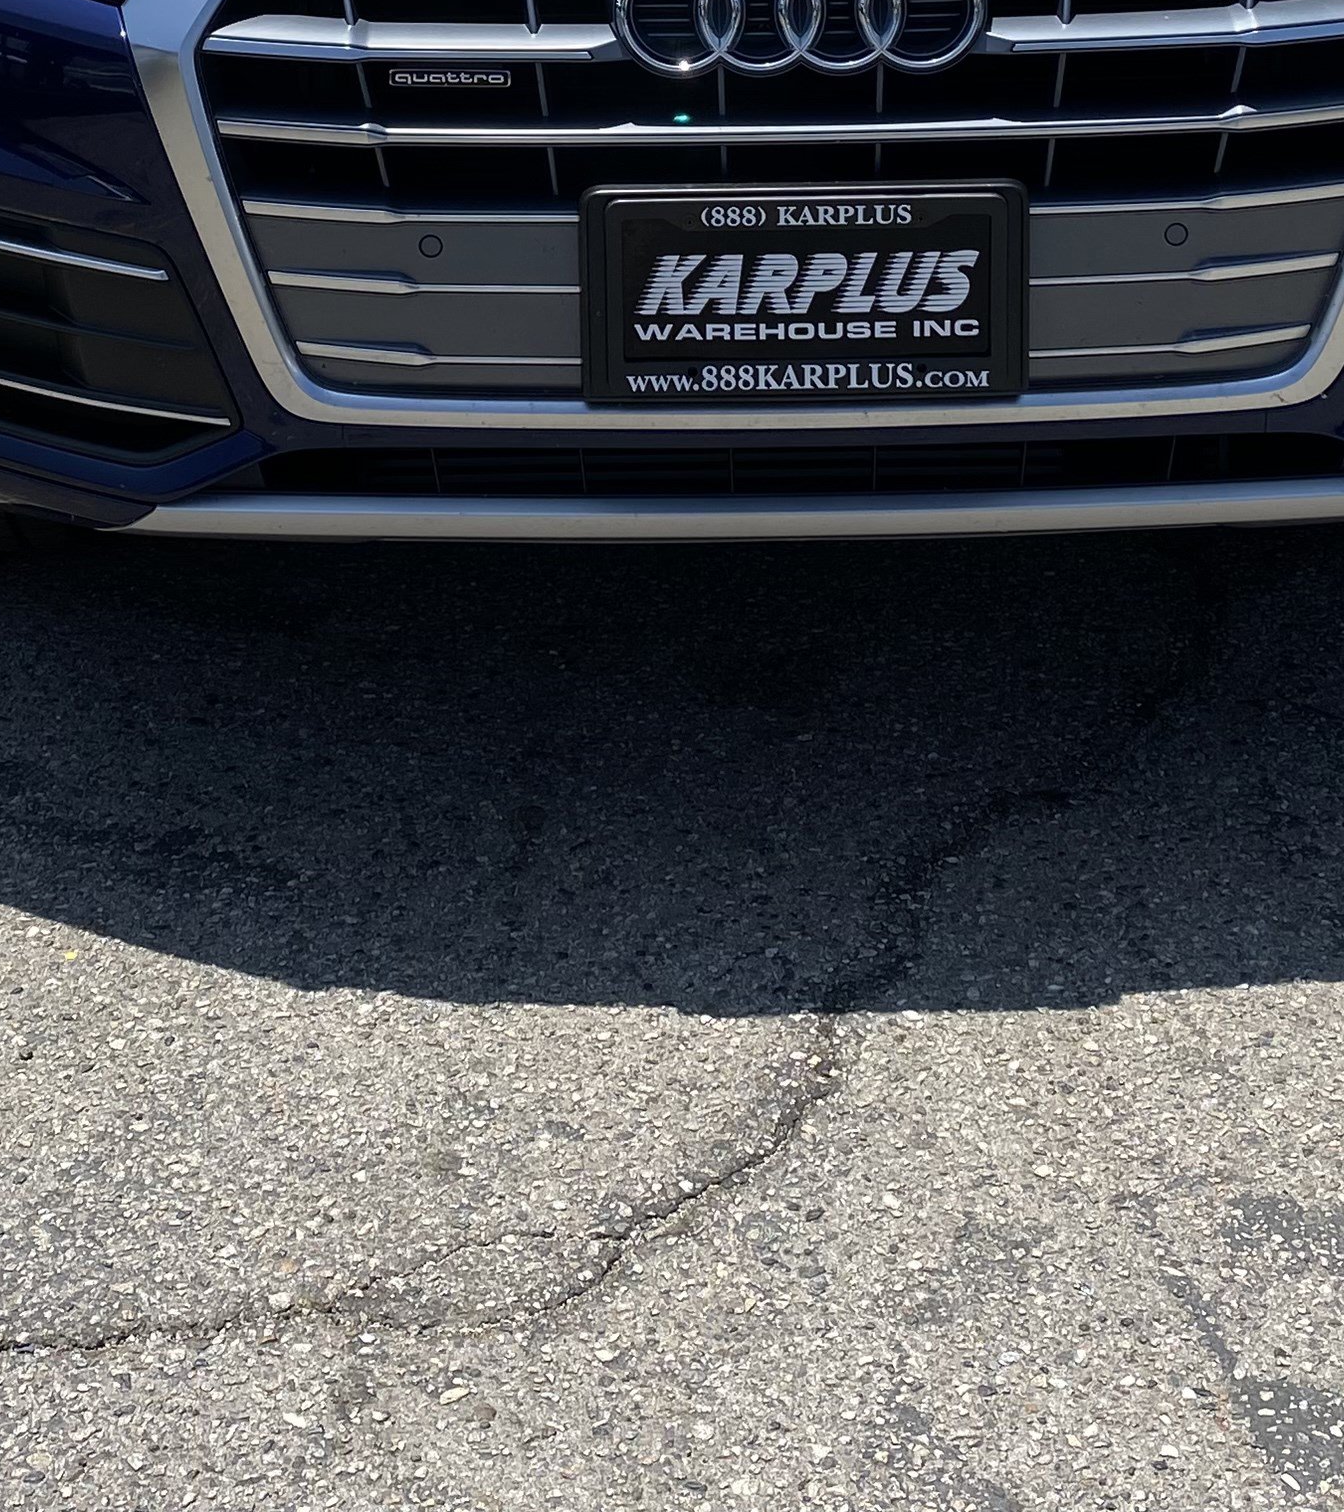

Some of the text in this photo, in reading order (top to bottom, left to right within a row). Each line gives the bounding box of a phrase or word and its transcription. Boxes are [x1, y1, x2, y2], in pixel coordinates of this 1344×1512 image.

[394, 72, 505, 85] quattro
[700, 204, 912, 227] (888) KARPLUS
[633, 249, 980, 316] KARPLUS
[634, 319, 980, 341] WAREHOUSE INC
